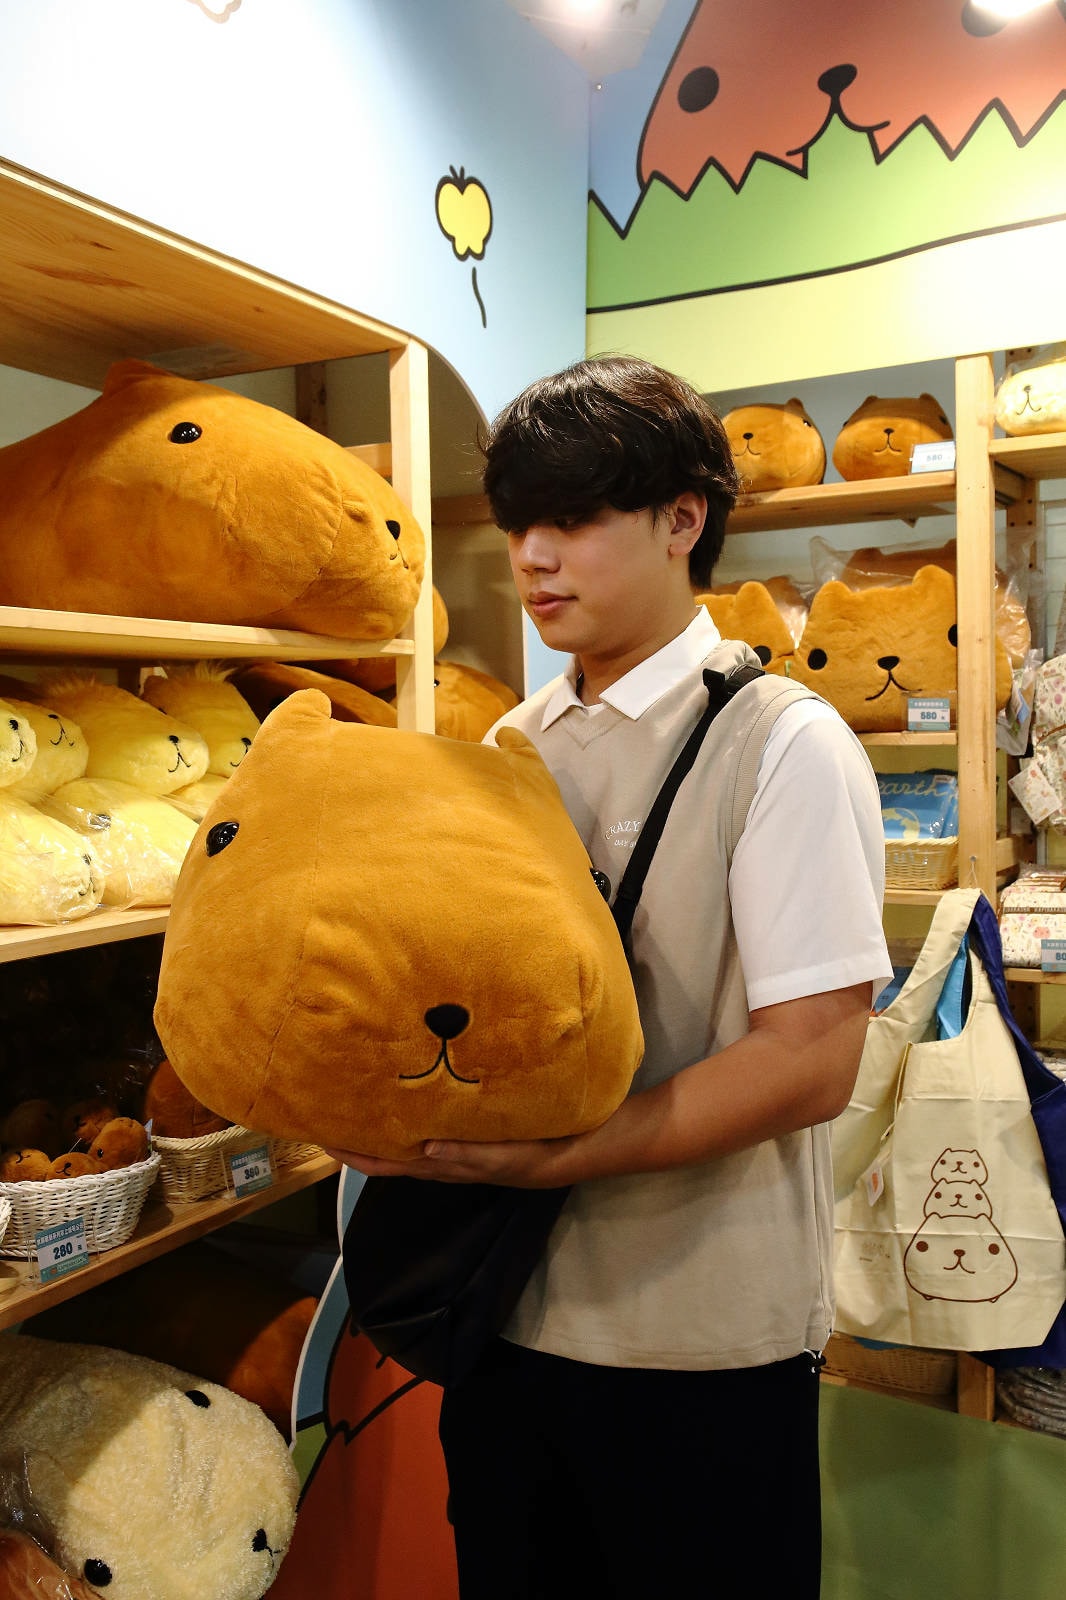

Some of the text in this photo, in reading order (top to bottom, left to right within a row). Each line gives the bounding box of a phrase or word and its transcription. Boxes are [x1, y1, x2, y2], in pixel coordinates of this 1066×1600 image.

[920, 711, 937, 720] 580
[605, 820, 641, 840] CRAZY
[53, 1242, 73, 1260] 280
